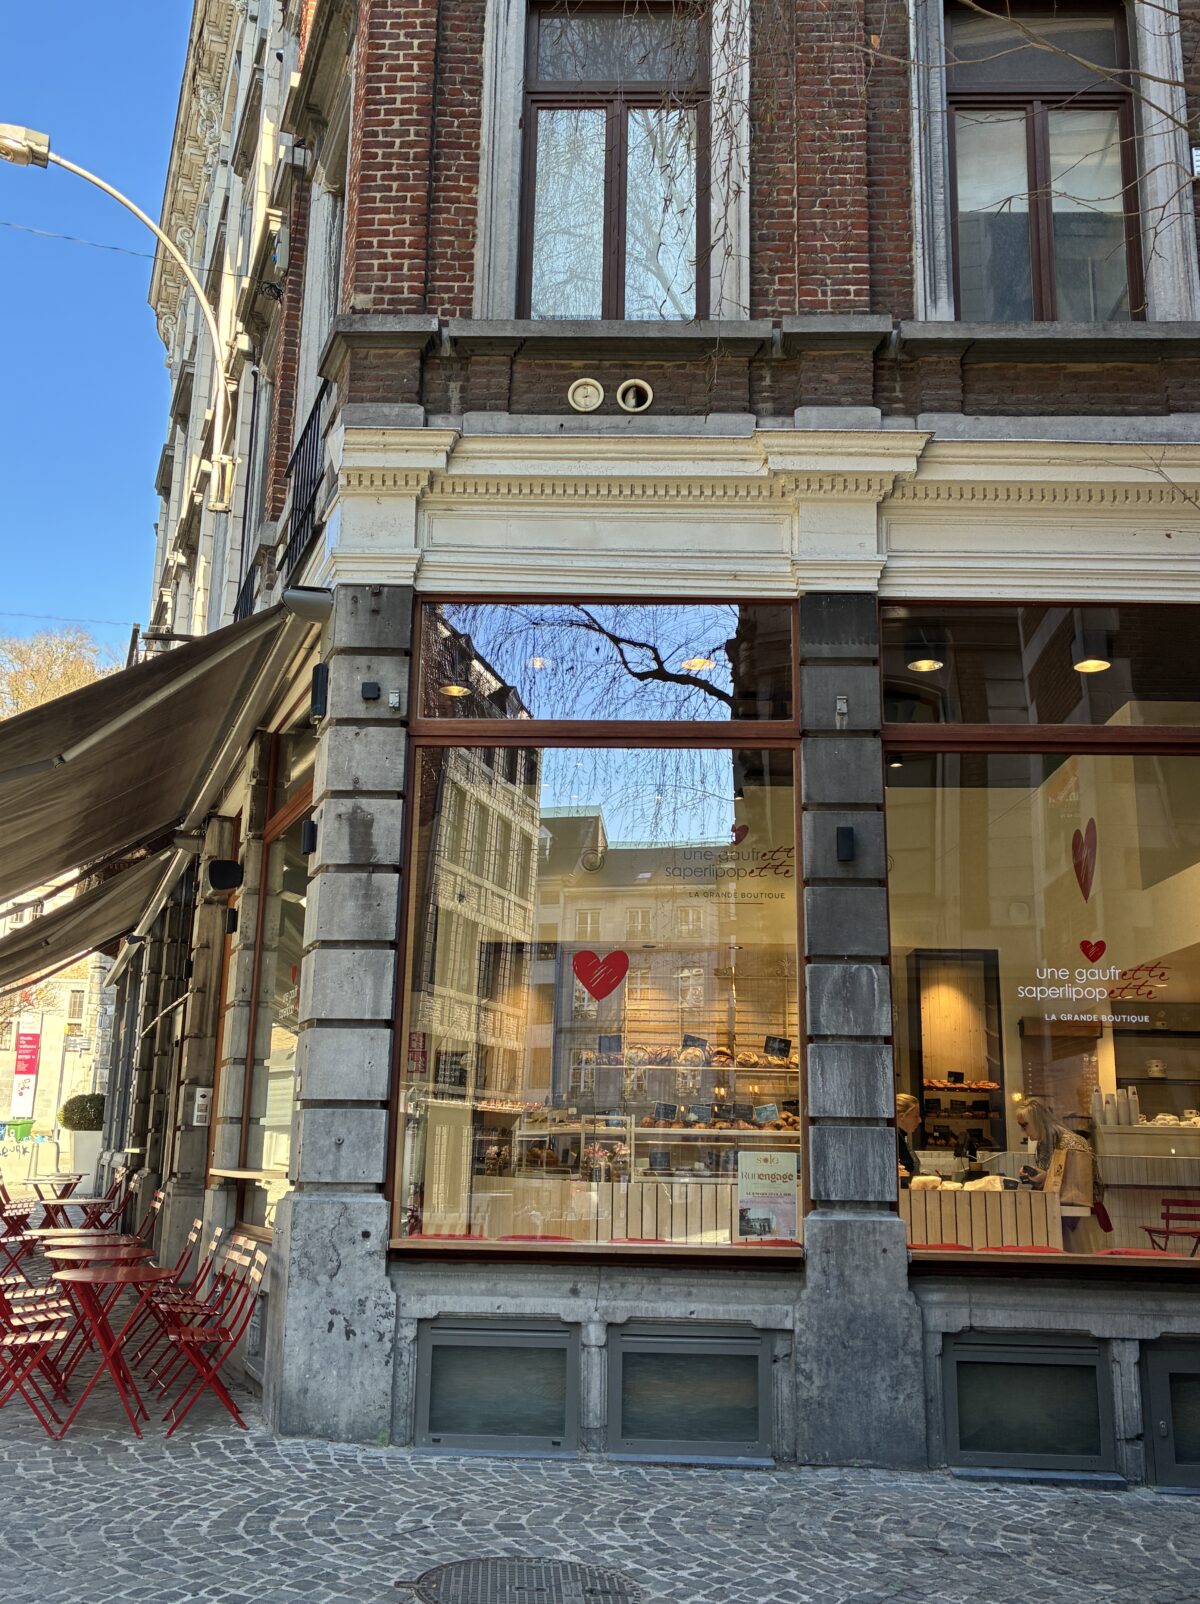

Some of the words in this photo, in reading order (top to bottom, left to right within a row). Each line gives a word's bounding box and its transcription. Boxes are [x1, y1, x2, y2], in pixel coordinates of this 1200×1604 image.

[683, 850, 713, 861] une
[665, 860, 794, 880] saperlipopette
[741, 892, 785, 900] BOUTIQUE
[1036, 967, 1070, 981] une
[1074, 961, 1170, 984] gaufrette
[1017, 980, 1158, 1002] saperlipopette
[1044, 1013, 1057, 1021] LA
[1060, 1013, 1098, 1022] GRANDE
[1101, 1014, 1150, 1024] BOUTIQUE
